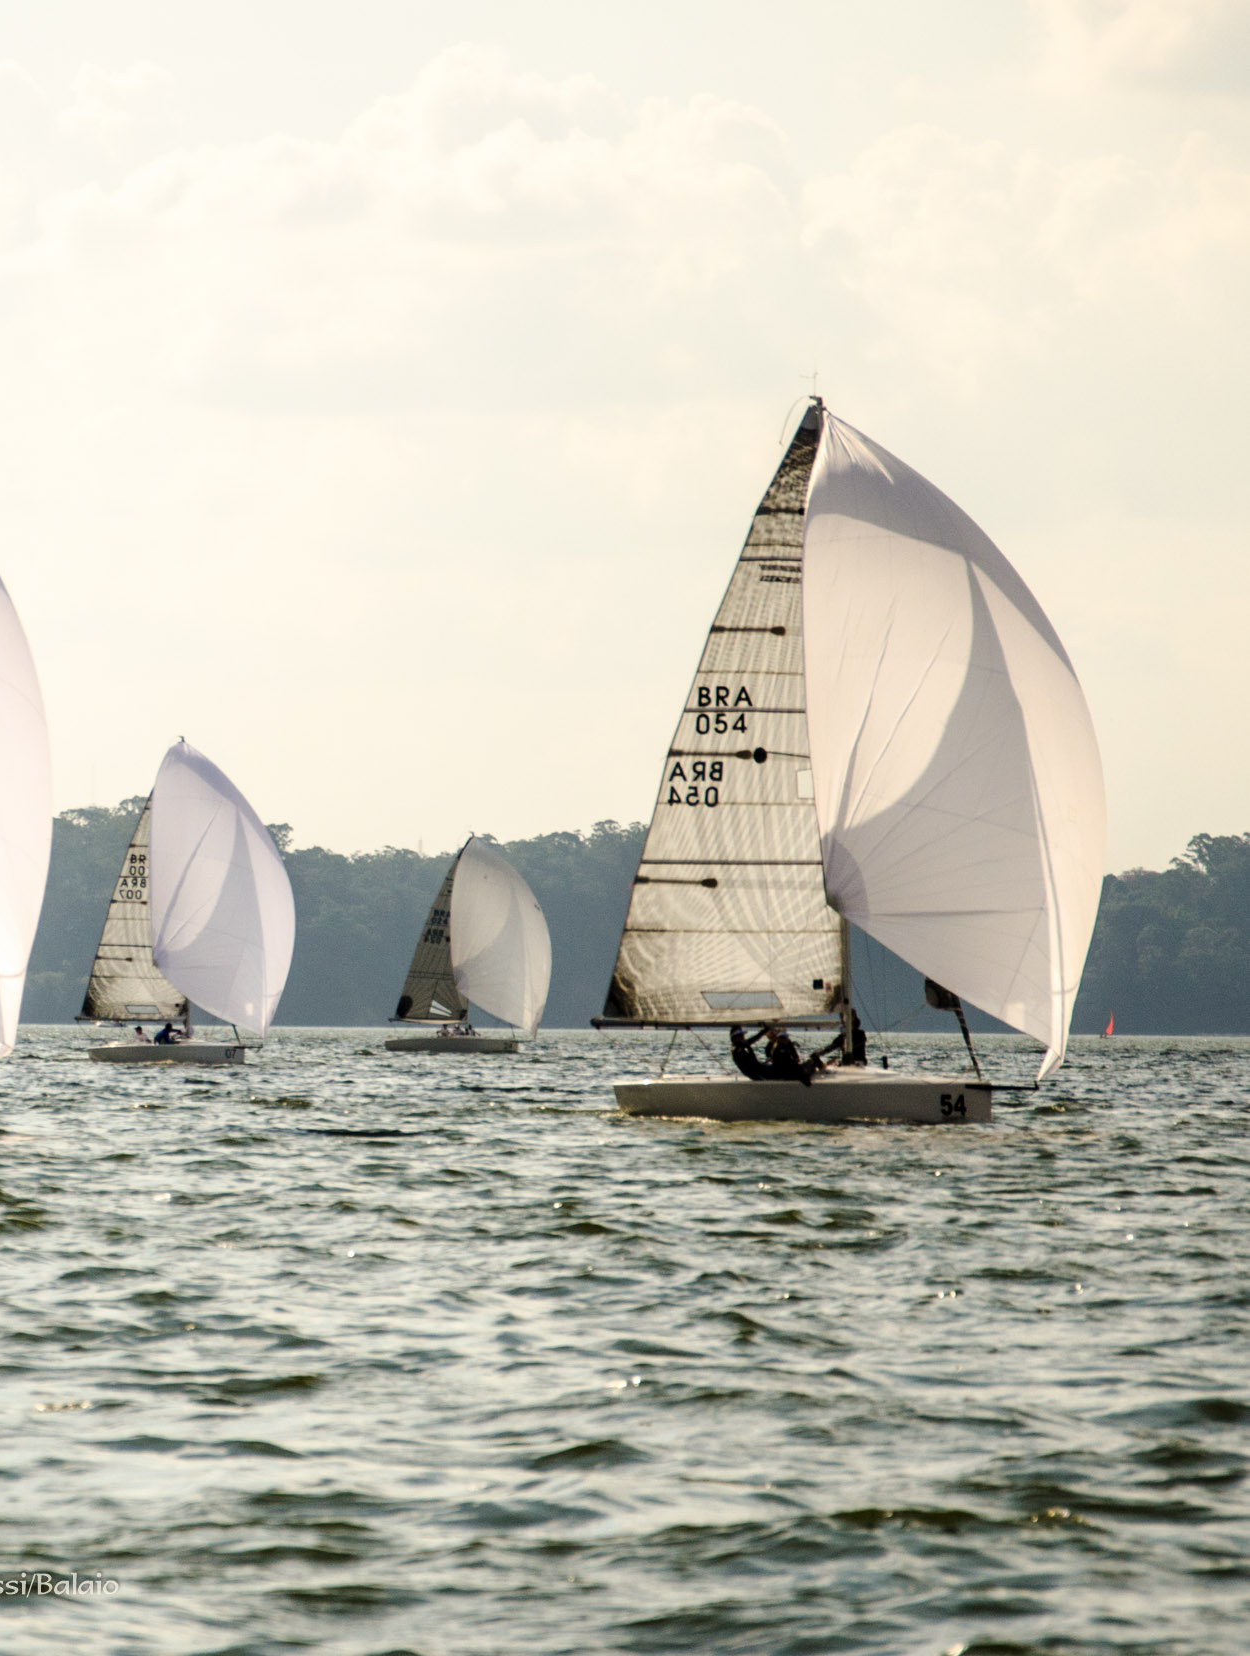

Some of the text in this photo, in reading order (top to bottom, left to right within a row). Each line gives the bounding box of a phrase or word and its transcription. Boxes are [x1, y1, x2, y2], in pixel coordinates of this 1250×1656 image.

[698, 686, 753, 707] BRA
[696, 713, 747, 735] 054
[130, 854, 146, 864] BR
[129, 866, 145, 876] 00
[941, 1094, 967, 1116] 54
